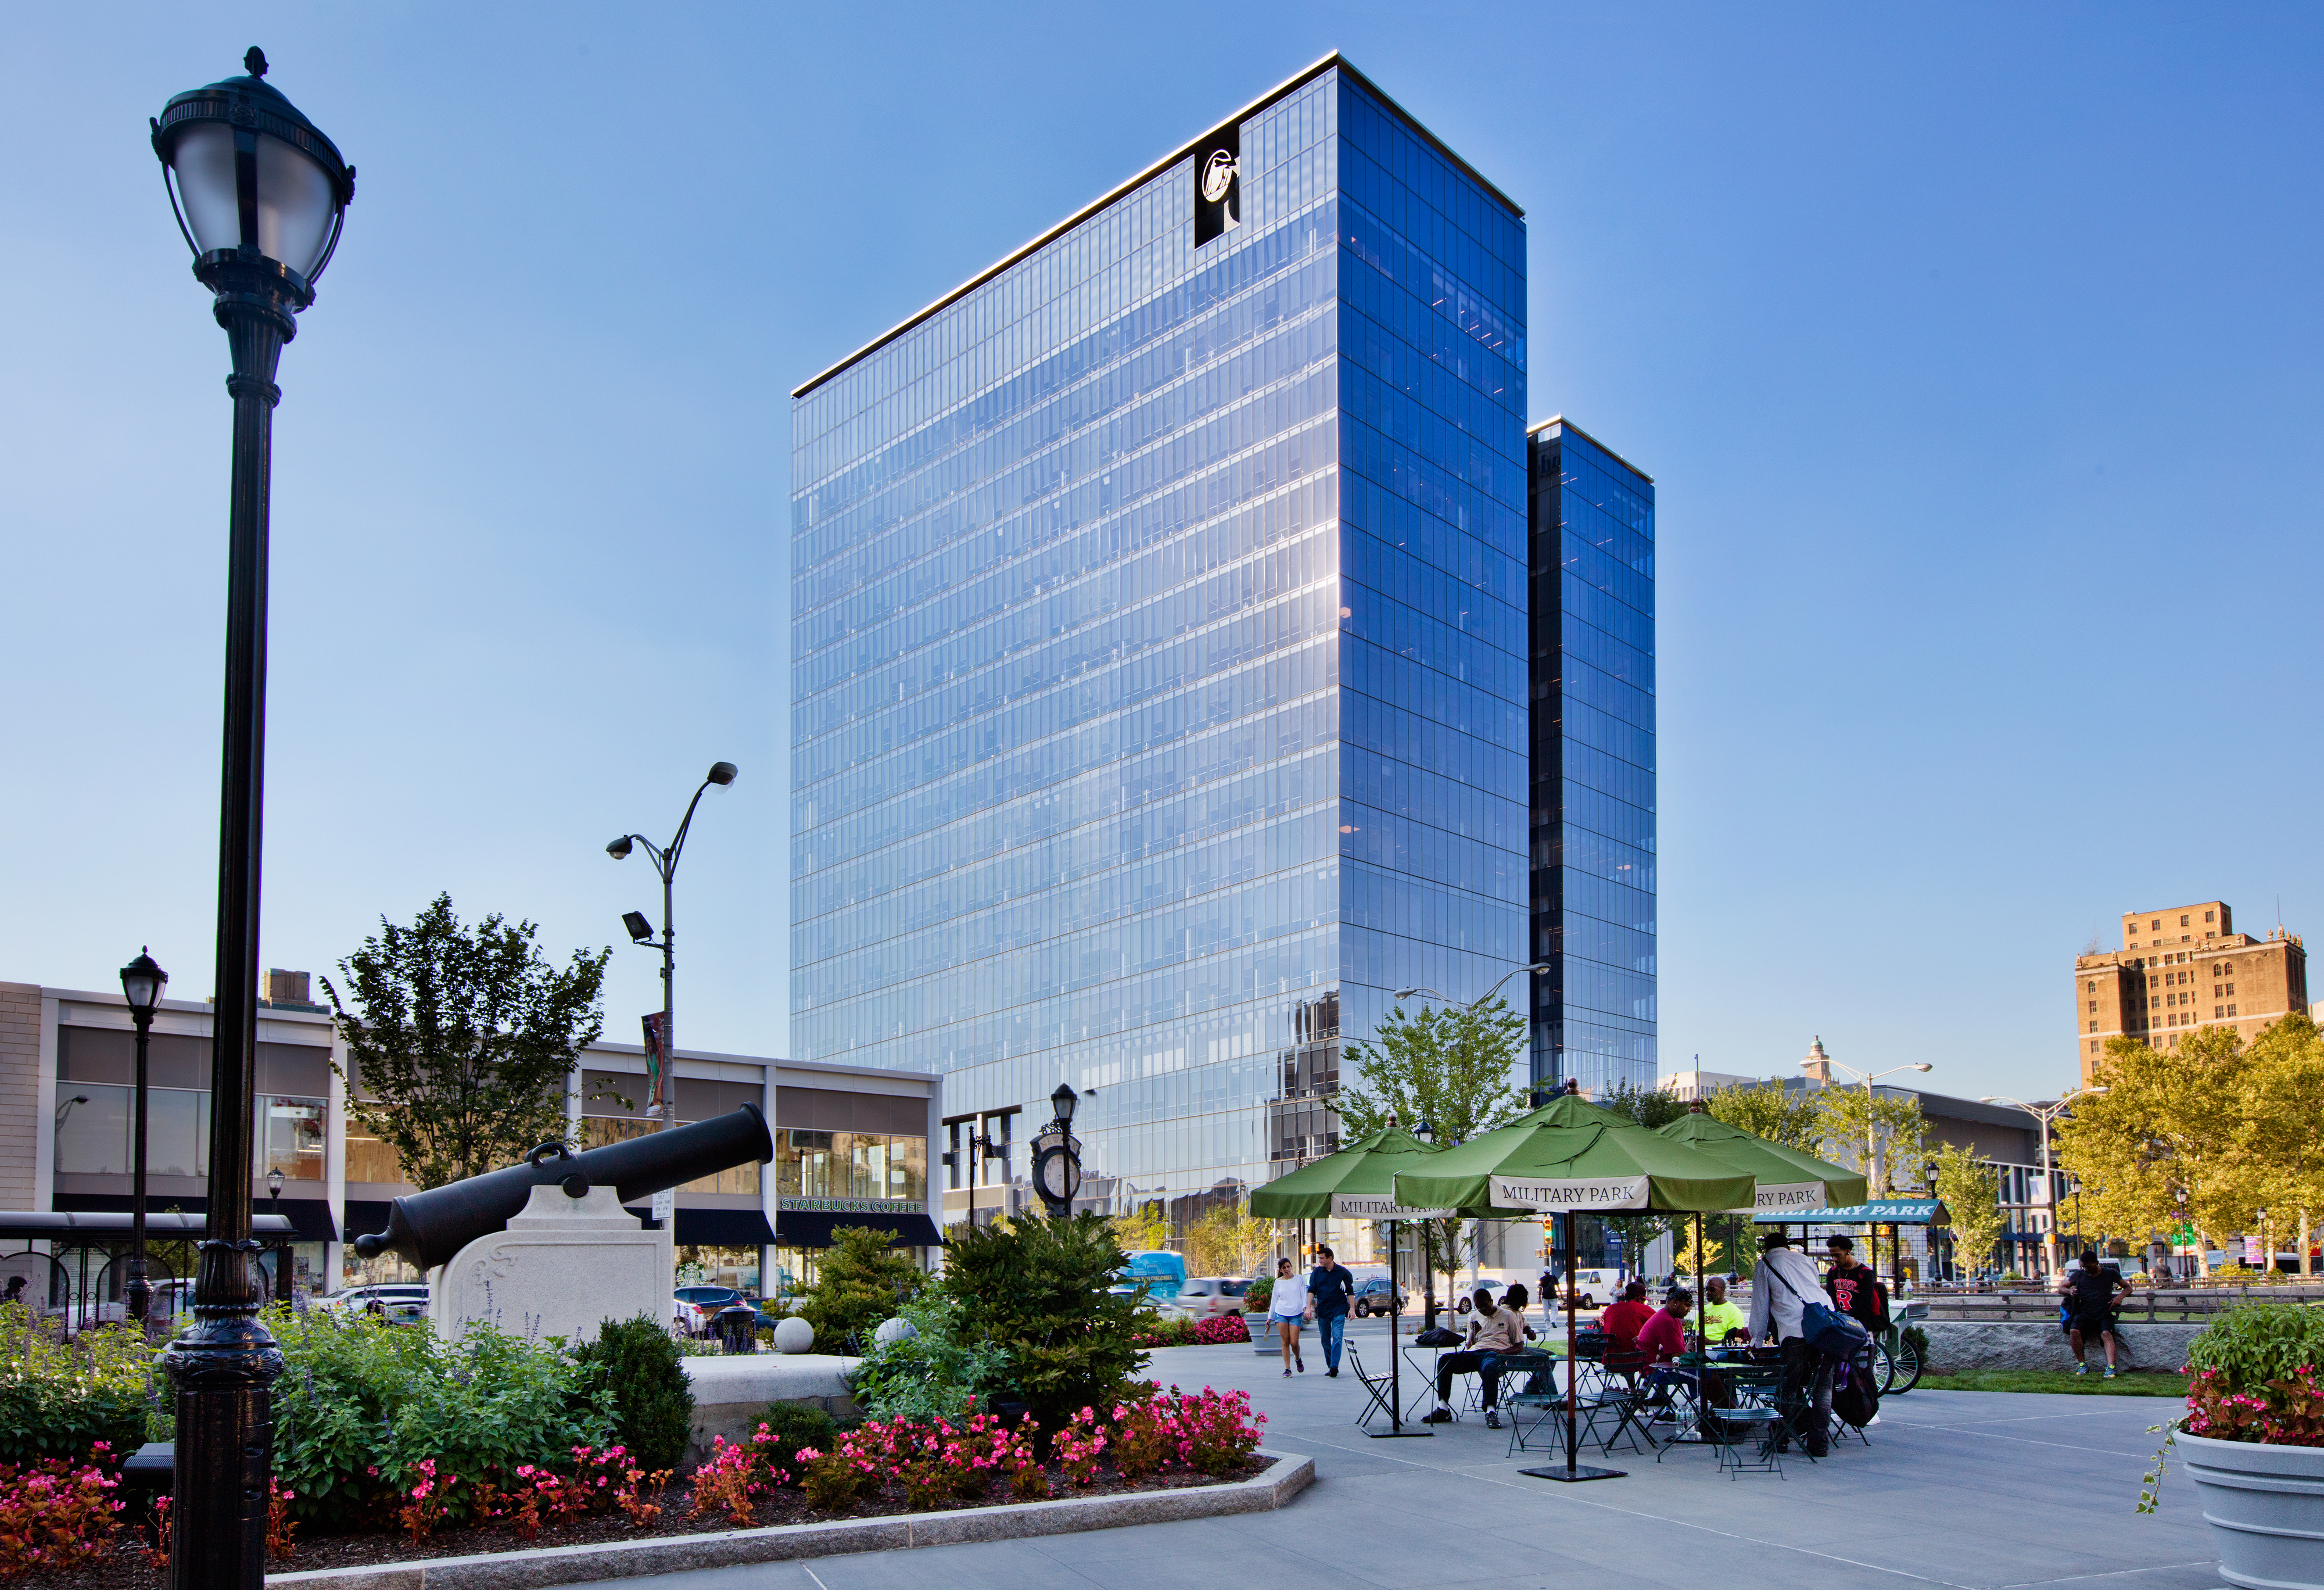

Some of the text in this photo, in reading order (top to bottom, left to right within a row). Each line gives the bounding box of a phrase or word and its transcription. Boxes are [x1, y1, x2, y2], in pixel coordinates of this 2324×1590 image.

[1040, 1136, 1078, 1151] NEWK
[1501, 1185, 1634, 1202] MILITARY PARK
[1778, 1190, 1816, 1205] PARK
[781, 1198, 923, 1213] STARBUCKS COFFEE
[1870, 1205, 1935, 1216] PARK
[1836, 1290, 1853, 1311] R
